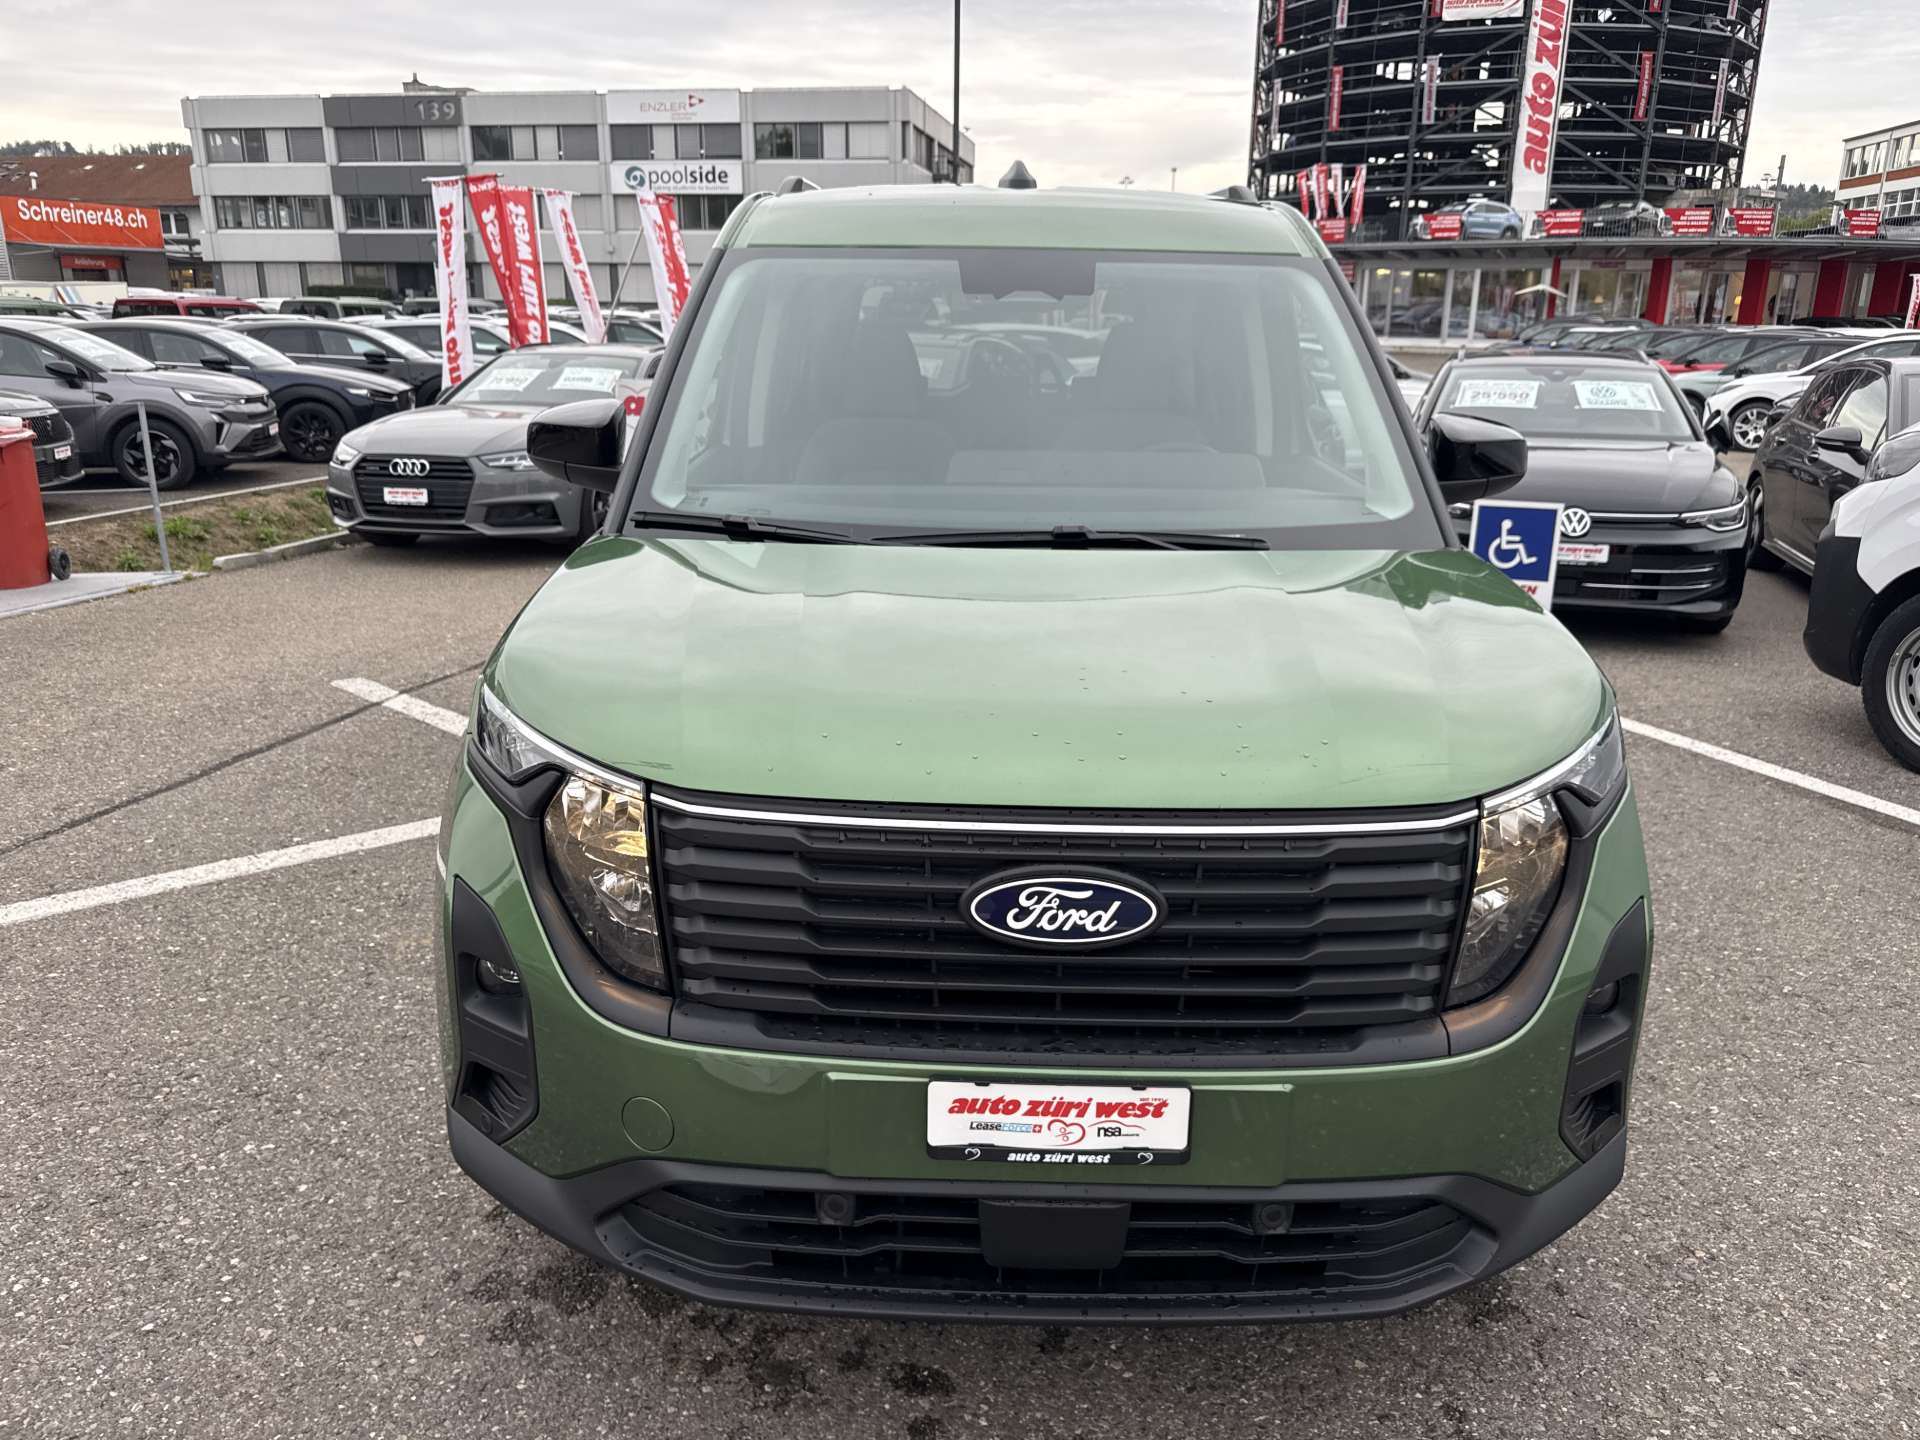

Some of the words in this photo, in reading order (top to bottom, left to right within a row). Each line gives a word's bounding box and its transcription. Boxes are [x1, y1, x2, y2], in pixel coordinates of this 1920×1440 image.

[1532, 0, 1567, 70] zü
[418, 102, 455, 120] 139
[640, 102, 687, 112] ENZLER
[1523, 72, 1556, 175] auto
[648, 165, 729, 190] poolside
[17, 198, 148, 229] Schreiner48.ch
[506, 201, 533, 261] west
[515, 261, 541, 317] züri
[1006, 886, 1121, 933] Ford
[948, 1095, 1022, 1116] auto
[1022, 1096, 1093, 1118] züri
[1096, 1099, 1169, 1119] west
[1097, 1126, 1121, 1137] nsa
[1007, 1151, 1041, 1162] auto
[1043, 1151, 1074, 1163] züri
[1077, 1153, 1111, 1164] west
